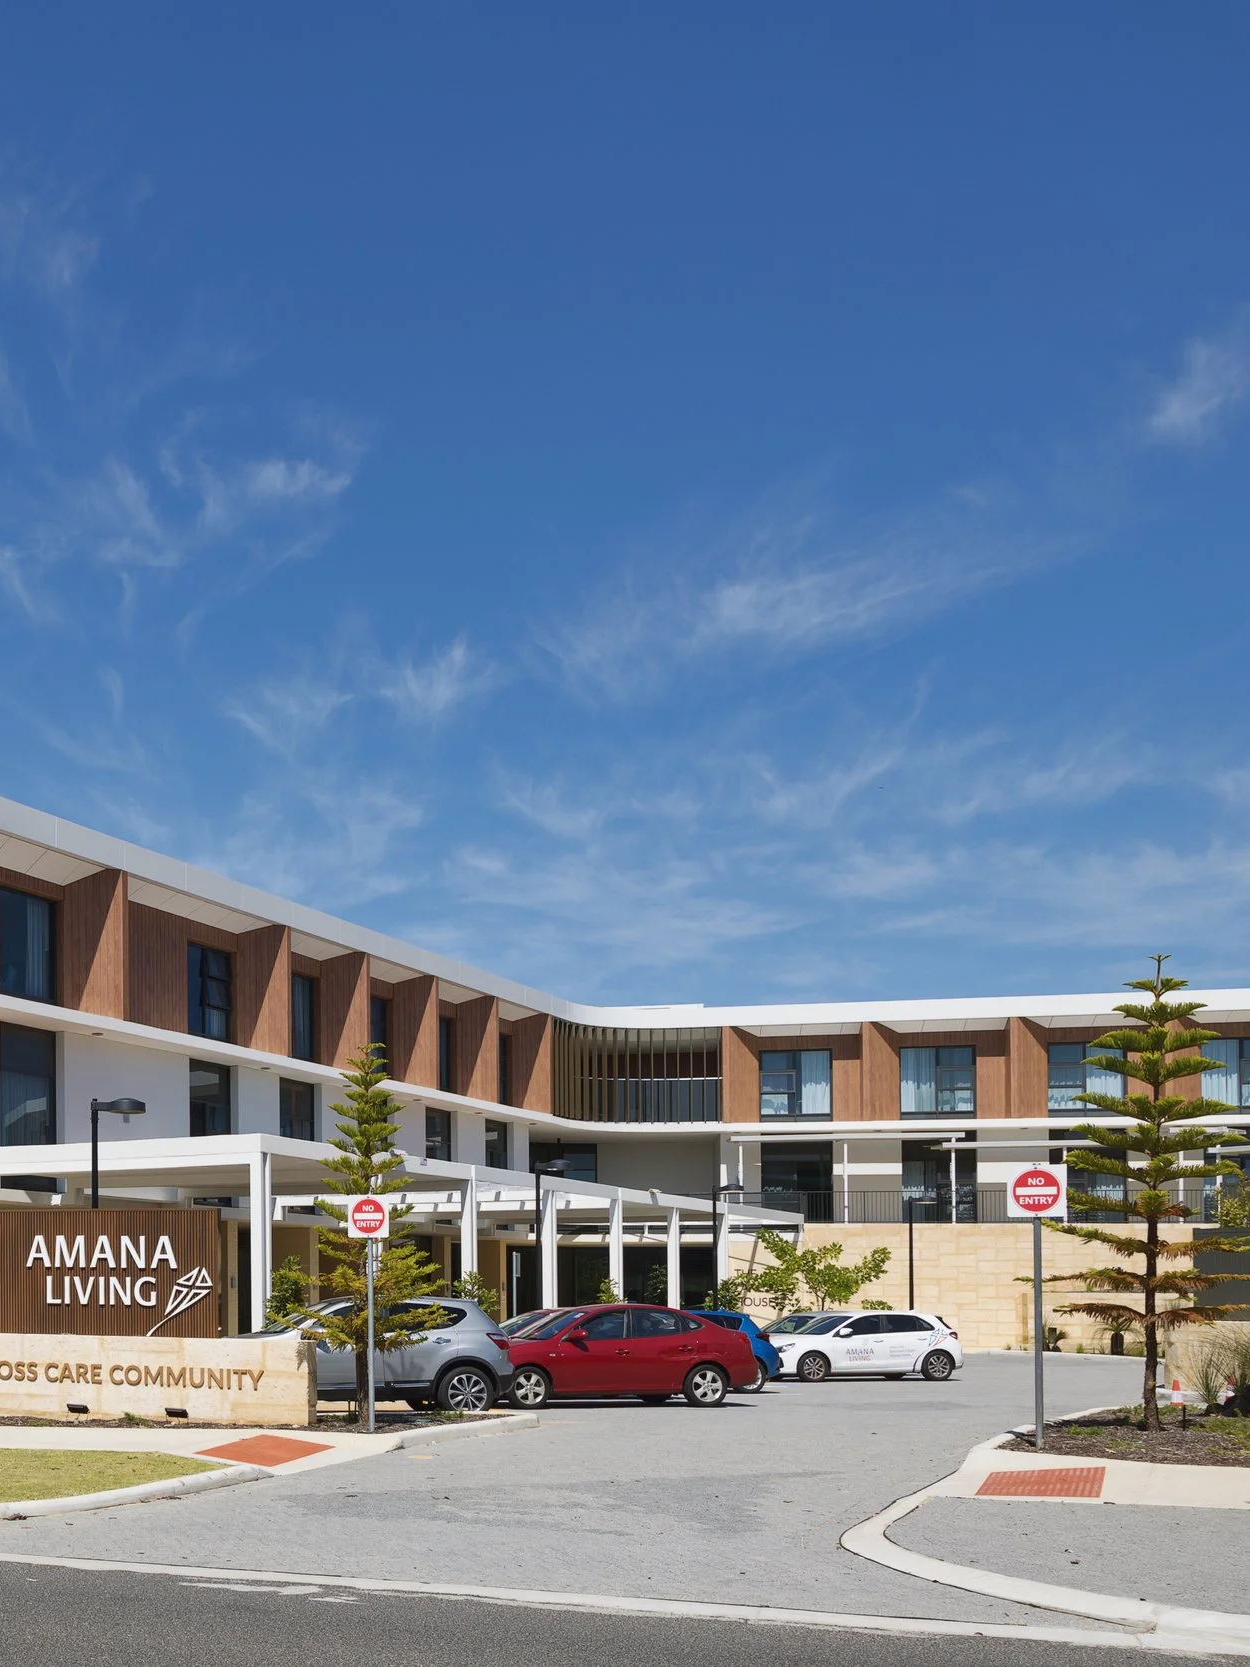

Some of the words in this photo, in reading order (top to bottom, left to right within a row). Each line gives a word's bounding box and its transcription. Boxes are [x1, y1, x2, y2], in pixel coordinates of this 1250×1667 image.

[1027, 1177, 1045, 1186] NO
[1019, 1196, 1054, 1205] ENTRY
[362, 1204, 375, 1212] NO
[356, 1220, 381, 1228] ENTRY
[25, 1234, 178, 1270] AMANA
[45, 1275, 157, 1307] LIVING
[845, 1347, 875, 1356] AMANA
[44, 1362, 102, 1385] CARE
[108, 1364, 265, 1392] COMMUNITY
